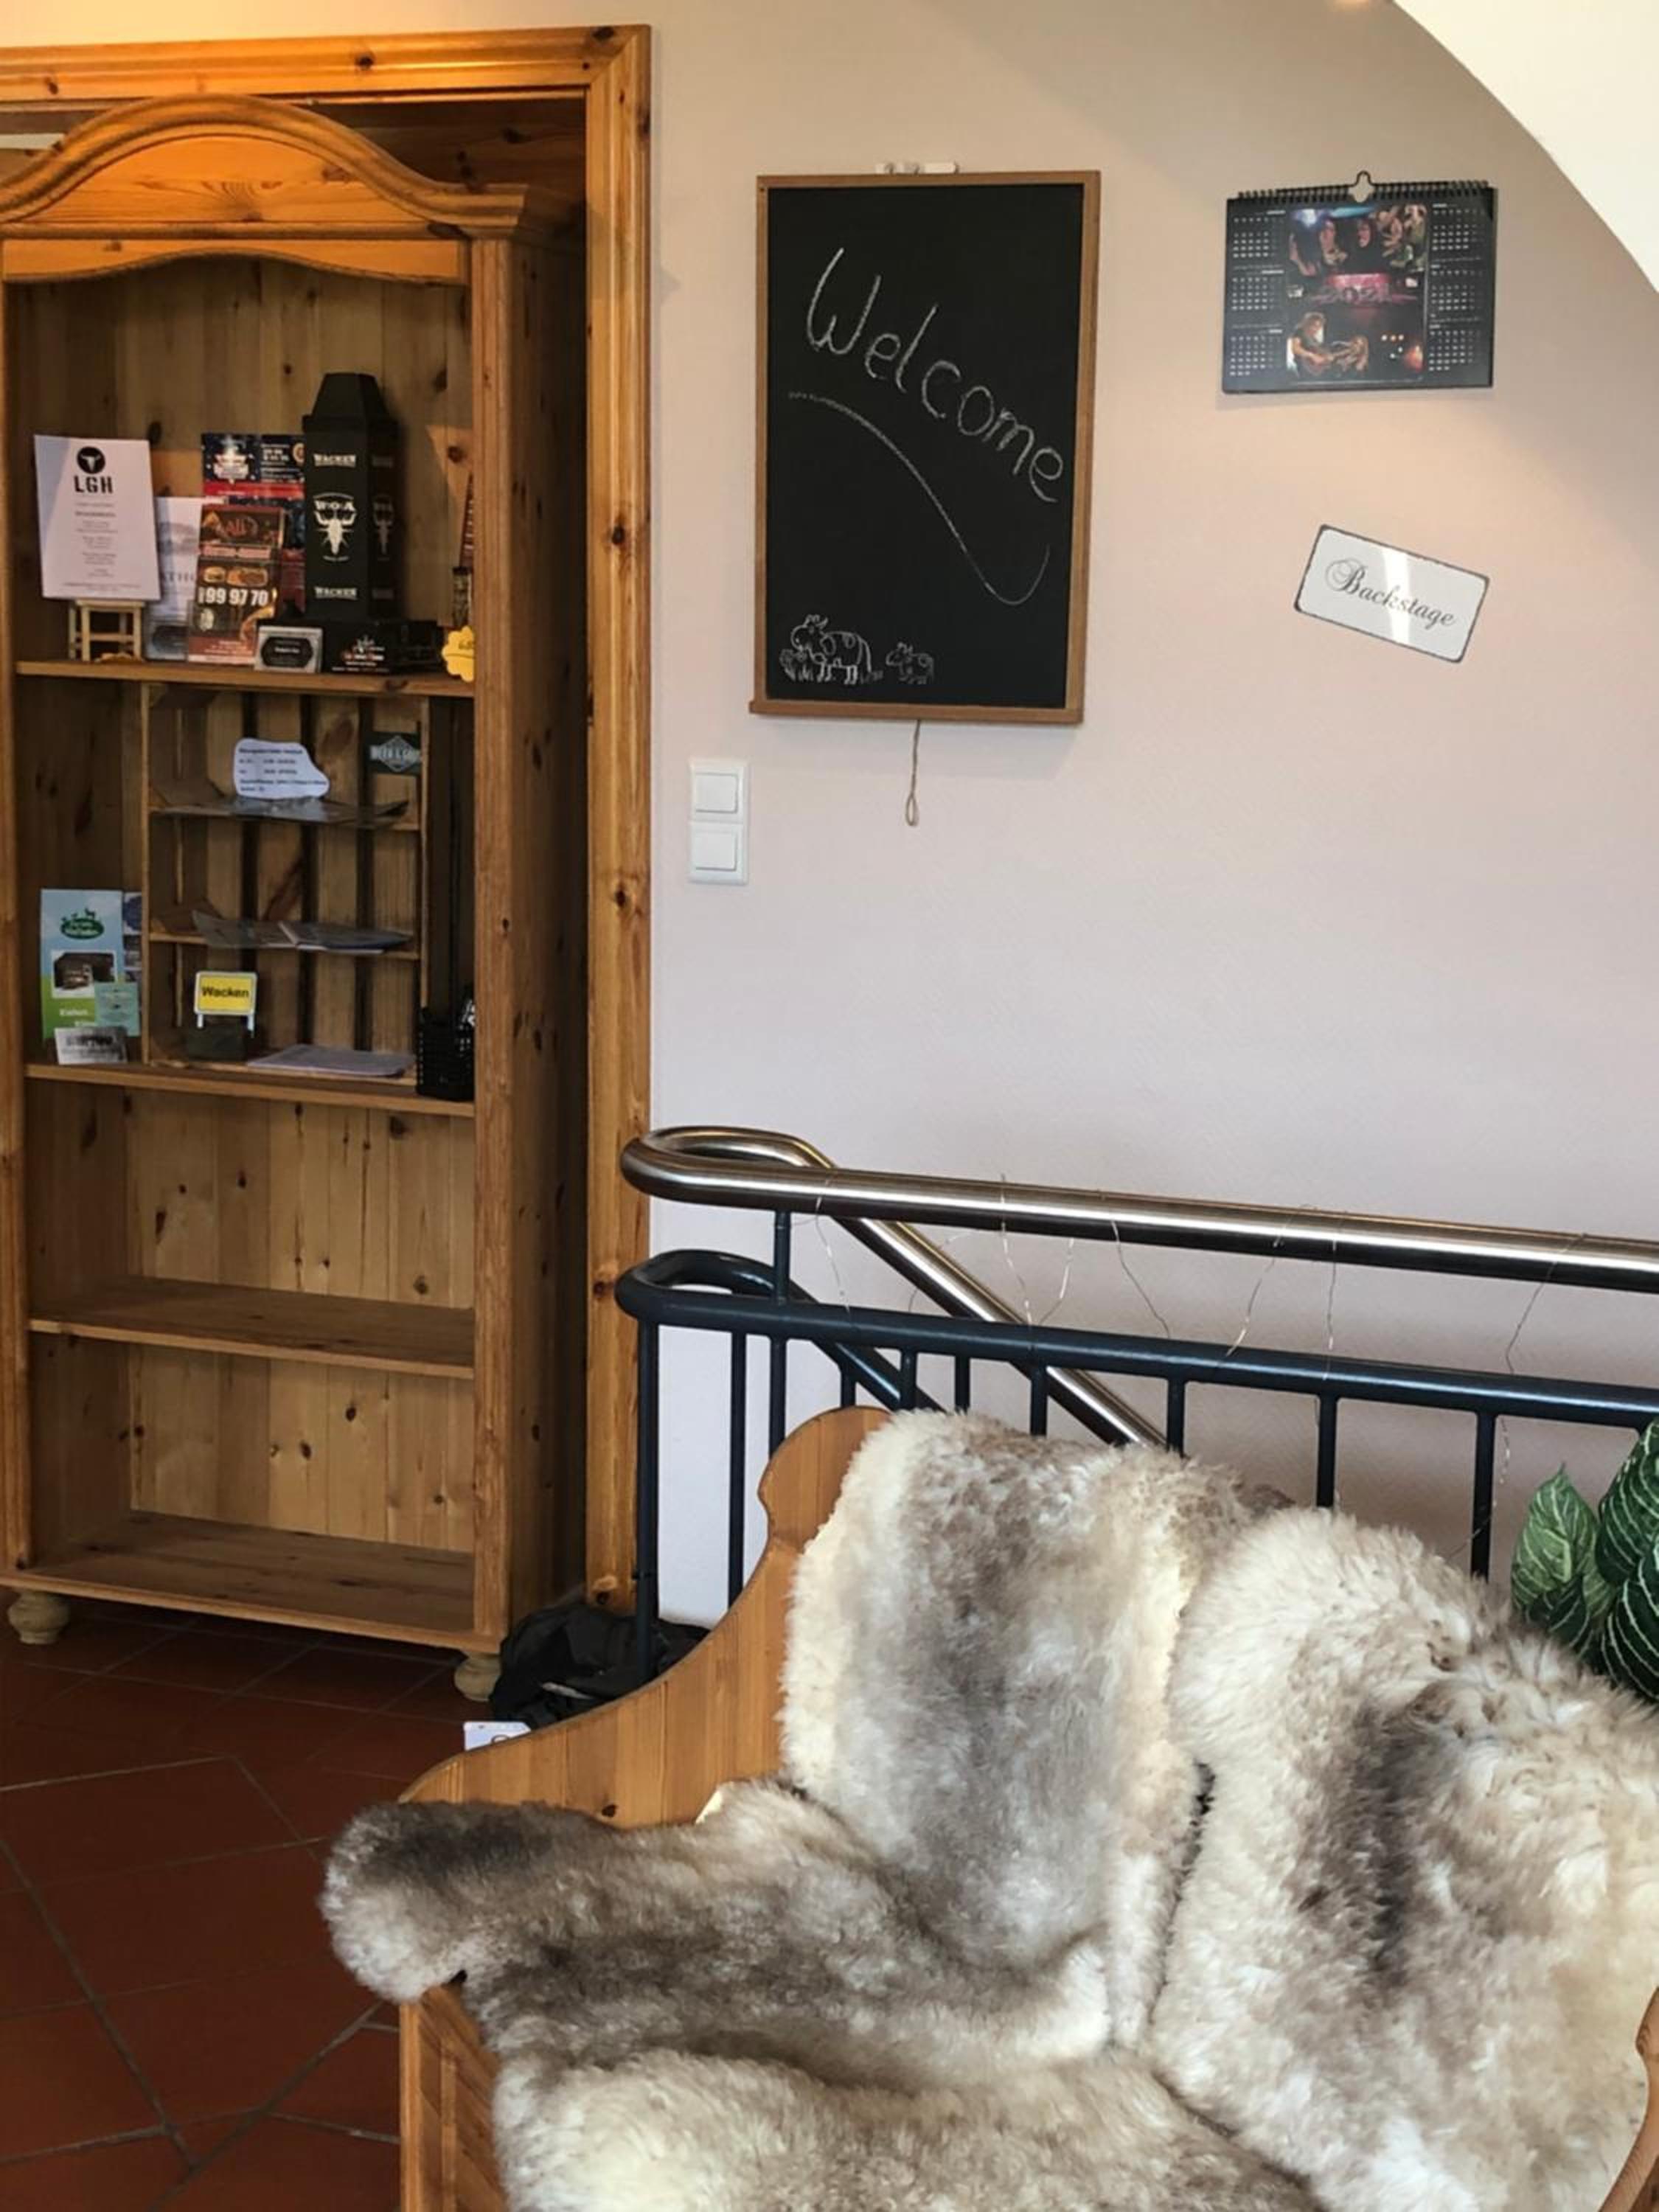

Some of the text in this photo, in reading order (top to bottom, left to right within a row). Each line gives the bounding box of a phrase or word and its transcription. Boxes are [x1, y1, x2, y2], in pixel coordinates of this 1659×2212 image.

[805, 247, 1064, 503] Welcome
[313, 453, 356, 464] WACKEN
[73, 475, 114, 494] LGH
[229, 588, 248, 606] 97
[251, 589, 269, 607] 70
[314, 586, 357, 597] WACKEN
[1325, 557, 1456, 630] Backstage
[201, 986, 250, 998] Wacken
